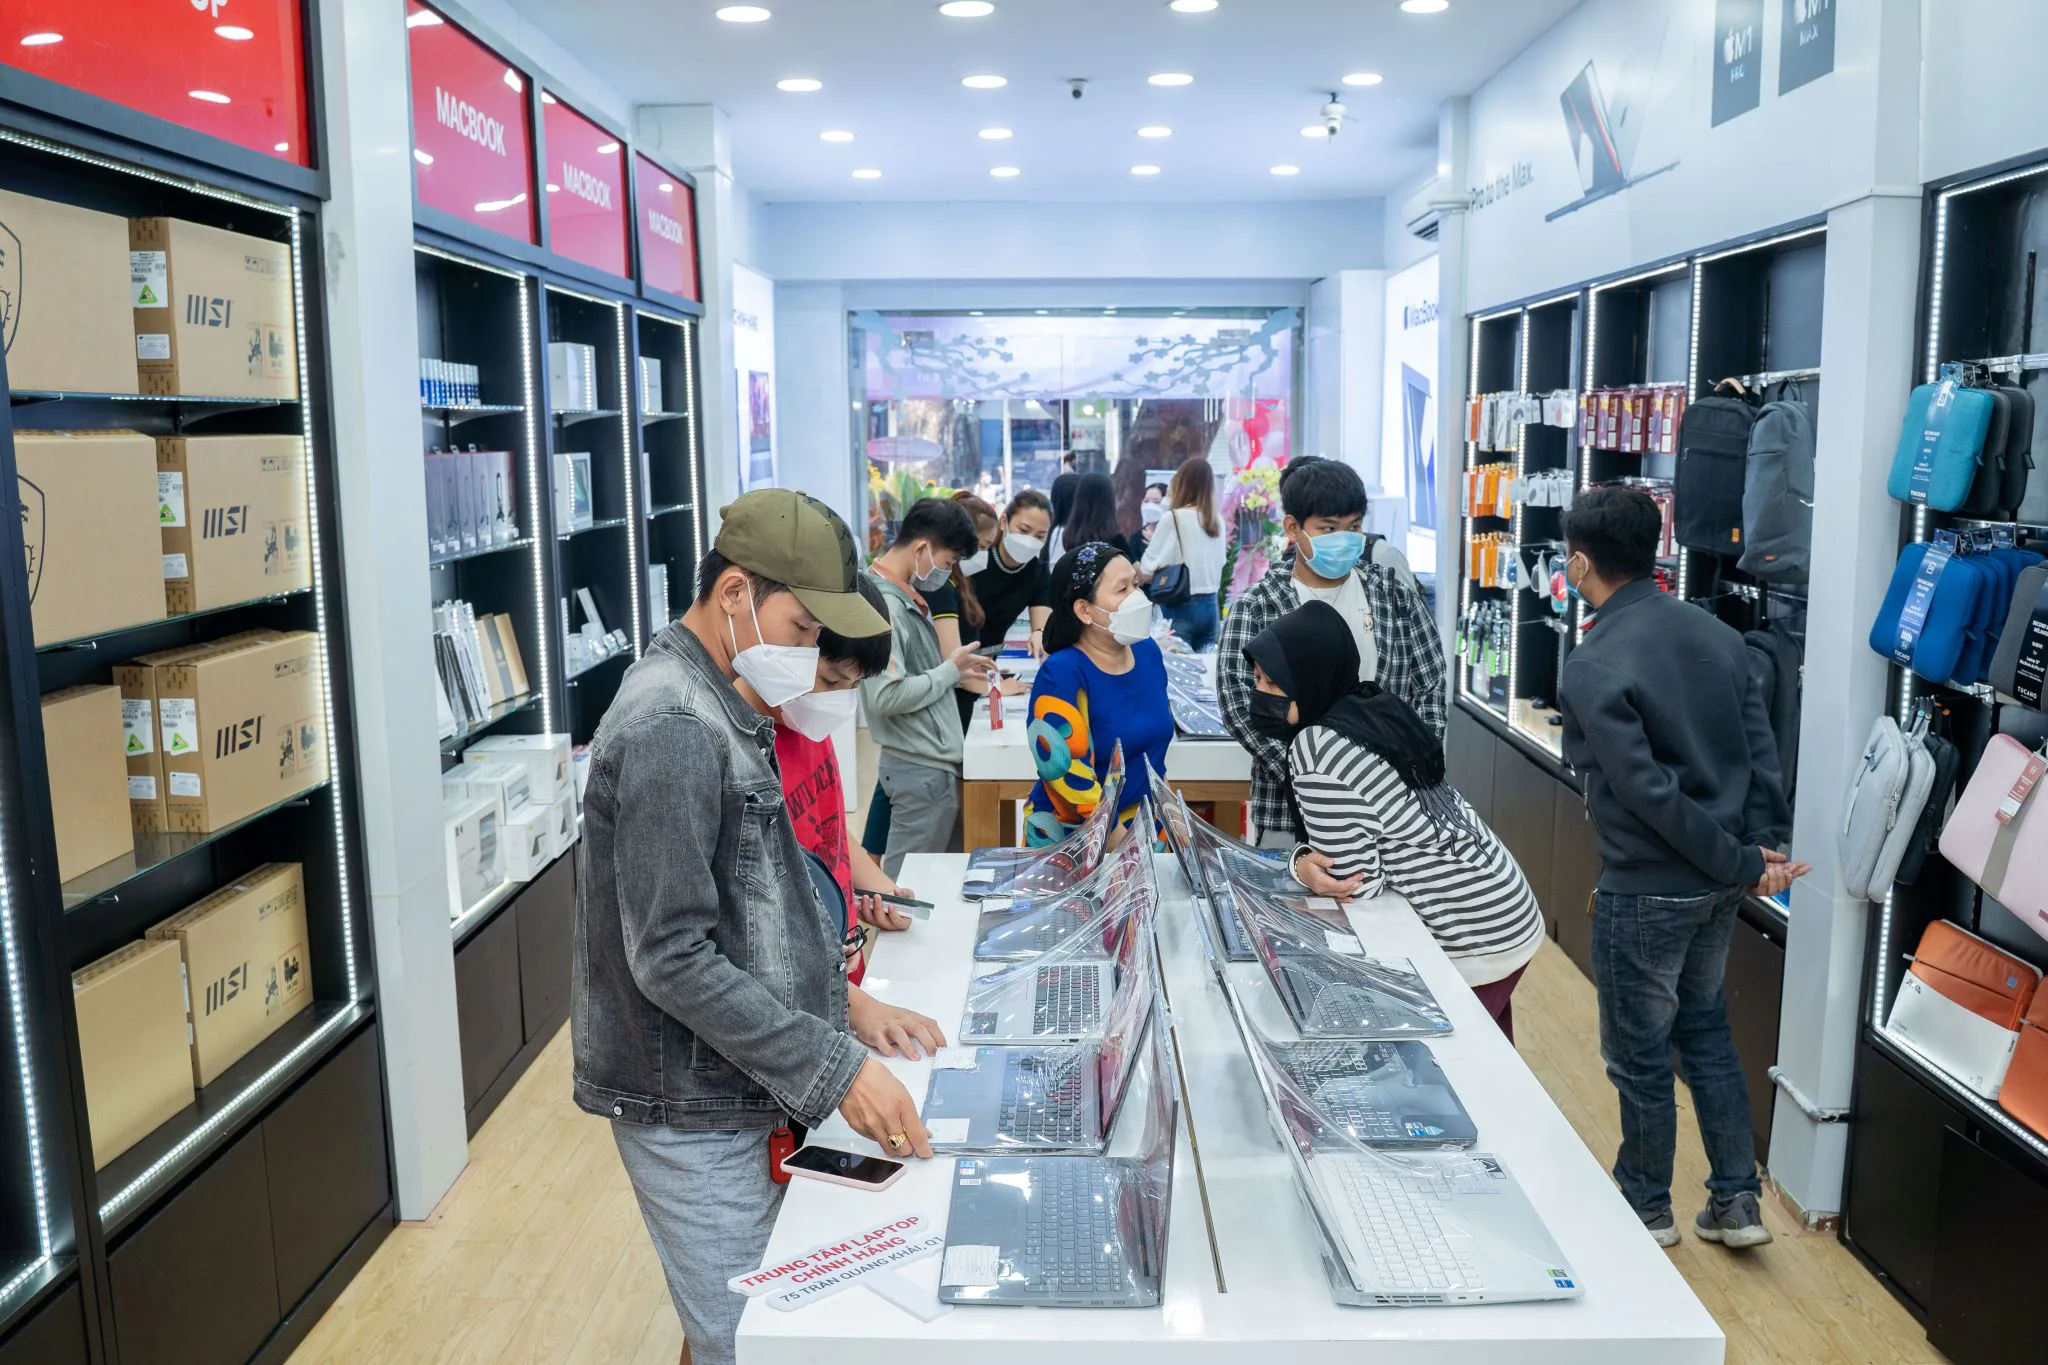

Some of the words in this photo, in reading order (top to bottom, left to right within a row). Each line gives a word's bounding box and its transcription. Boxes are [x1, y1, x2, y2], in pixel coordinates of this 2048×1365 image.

[1734, 25, 1752, 60] M1
[1799, 24, 1818, 46] MAX
[1730, 63, 1745, 83] PRO
[436, 86, 507, 157] MACBOOK
[563, 161, 613, 211] MACBOOK
[1486, 181, 1494, 206] to
[1496, 172, 1510, 200] the
[648, 208, 684, 246] MACBOOK
[2017, 686, 2038, 699] TUCANO
[740, 1259, 810, 1287] TRUNG
[806, 1243, 853, 1262] TÂM
[850, 1216, 920, 1247] LAPTOP
[779, 1291, 801, 1302] 75
[799, 1276, 841, 1295] TRẦN
[840, 1258, 889, 1280] QUANG
[925, 1236, 944, 1247] Q1
[791, 1256, 854, 1283] CHÍNH
[852, 1236, 907, 1261] HÃNG
